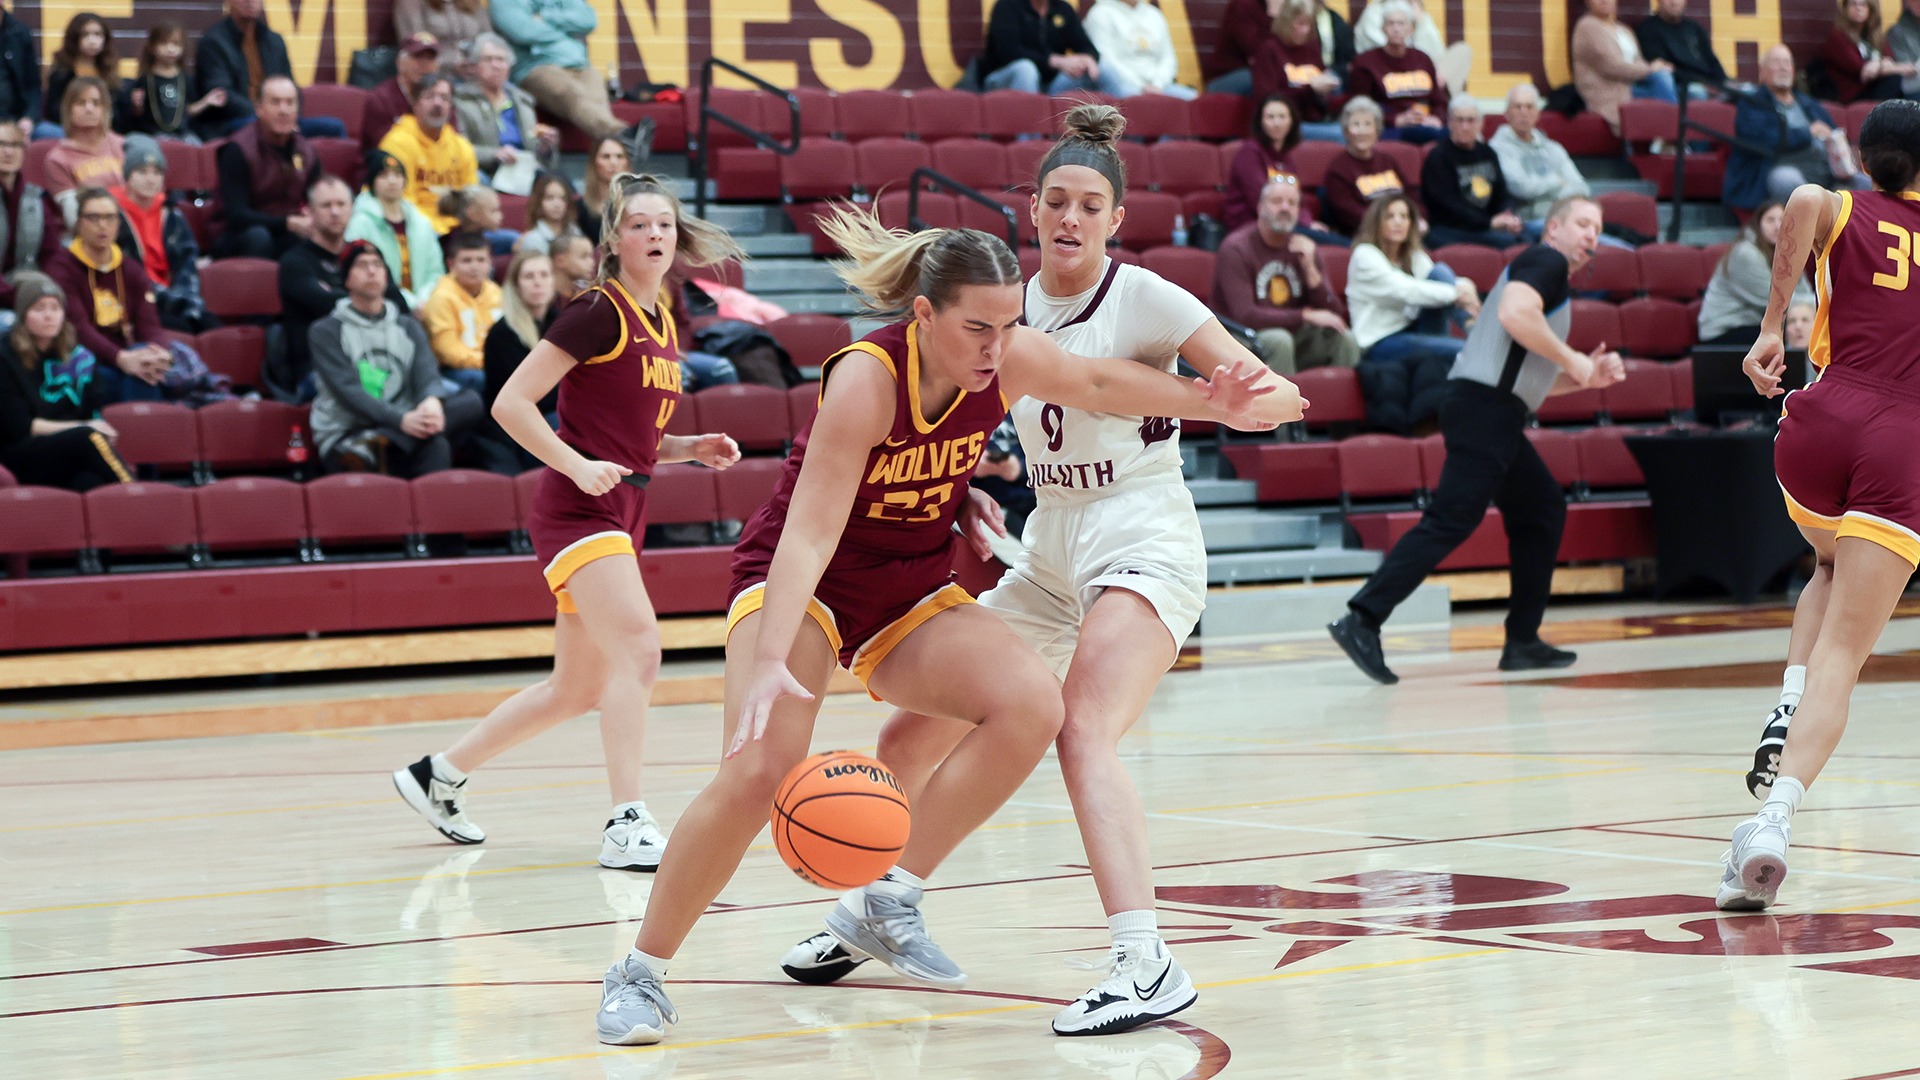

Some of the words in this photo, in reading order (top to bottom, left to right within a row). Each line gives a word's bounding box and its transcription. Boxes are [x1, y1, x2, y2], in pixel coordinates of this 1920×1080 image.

[1873, 220, 1920, 291] 3
[1041, 402, 1064, 452] 0
[866, 431, 985, 485] WOLVES
[866, 482, 954, 522] 23
